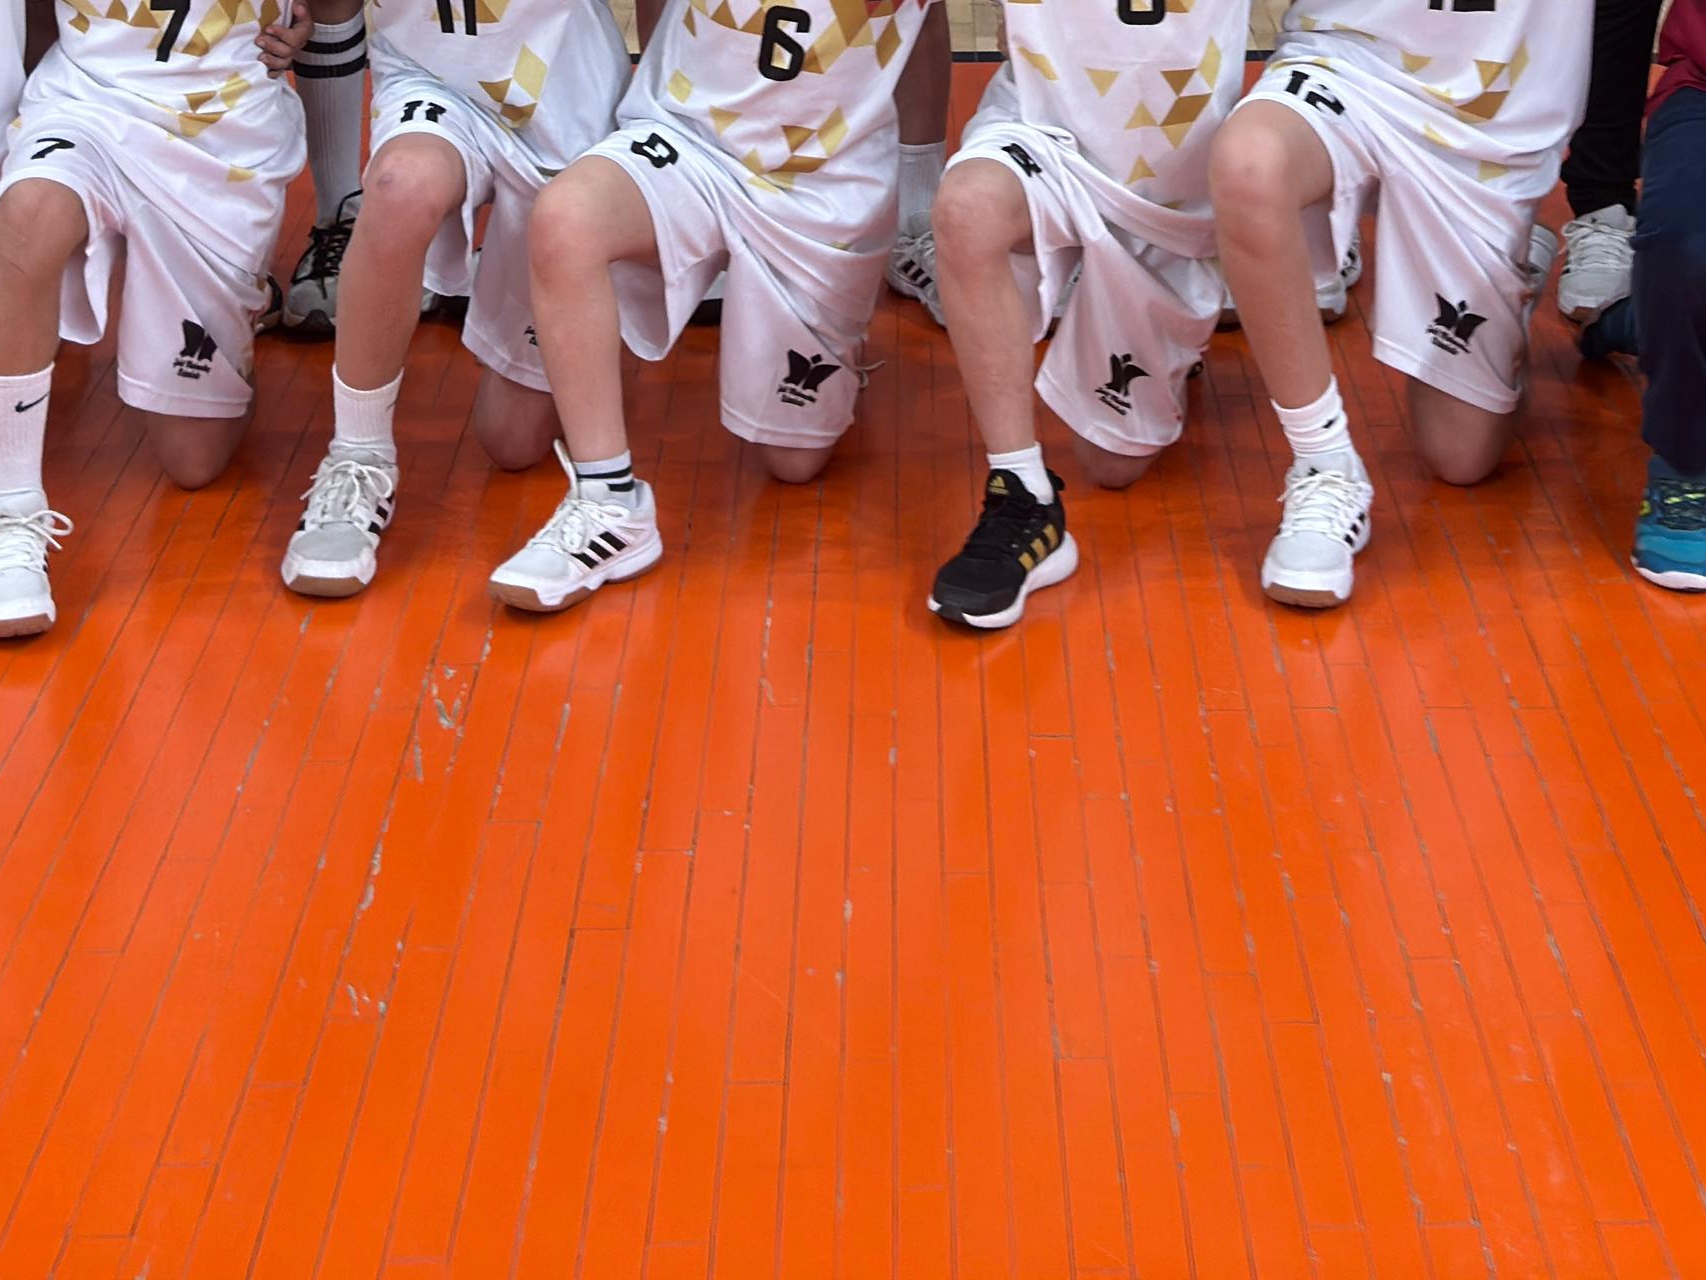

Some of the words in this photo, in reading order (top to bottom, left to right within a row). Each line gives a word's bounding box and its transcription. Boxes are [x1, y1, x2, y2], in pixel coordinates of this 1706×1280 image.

[758, 5, 810, 82] 6
[1284, 69, 1347, 116] 12
[30, 137, 75, 160] 7
